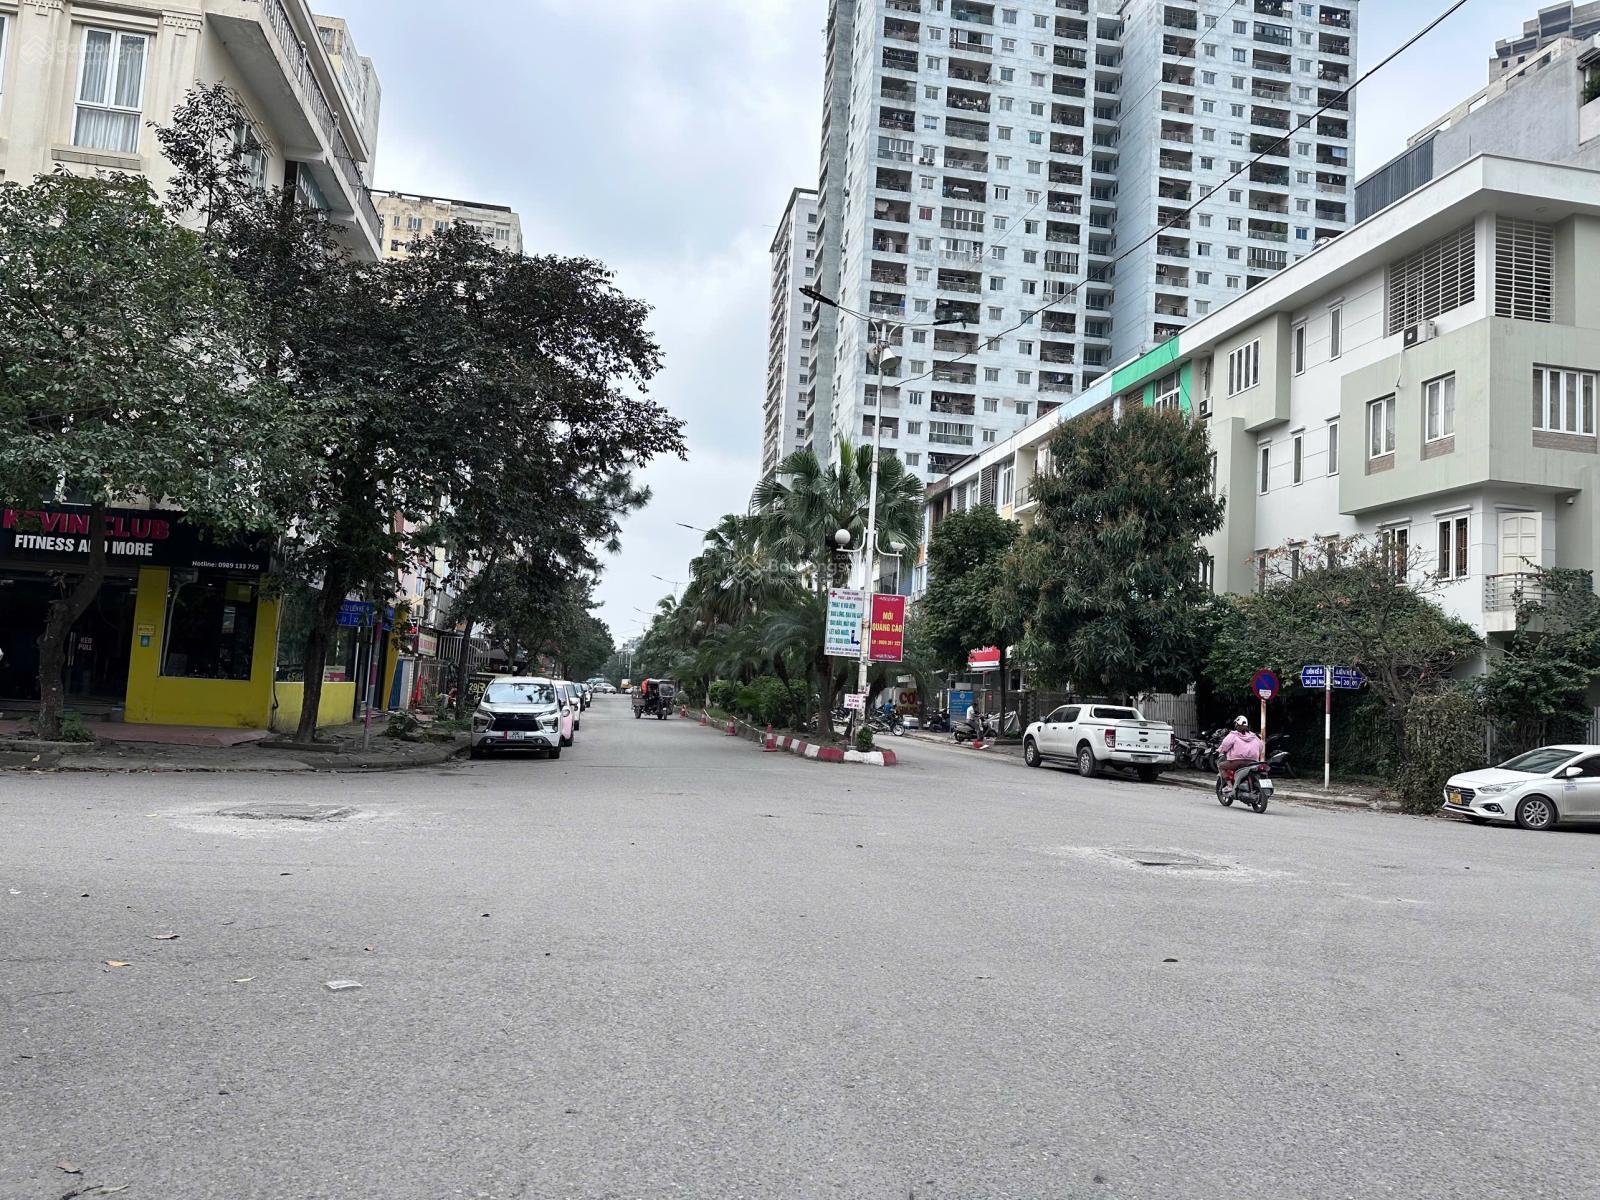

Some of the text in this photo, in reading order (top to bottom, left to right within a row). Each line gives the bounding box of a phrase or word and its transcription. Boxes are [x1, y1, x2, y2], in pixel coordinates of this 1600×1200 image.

[2, 508, 90, 535] KVIN
[14, 534, 76, 553] FITNESS
[111, 540, 154, 556] MORE
[191, 560, 217, 568] Hotline:
